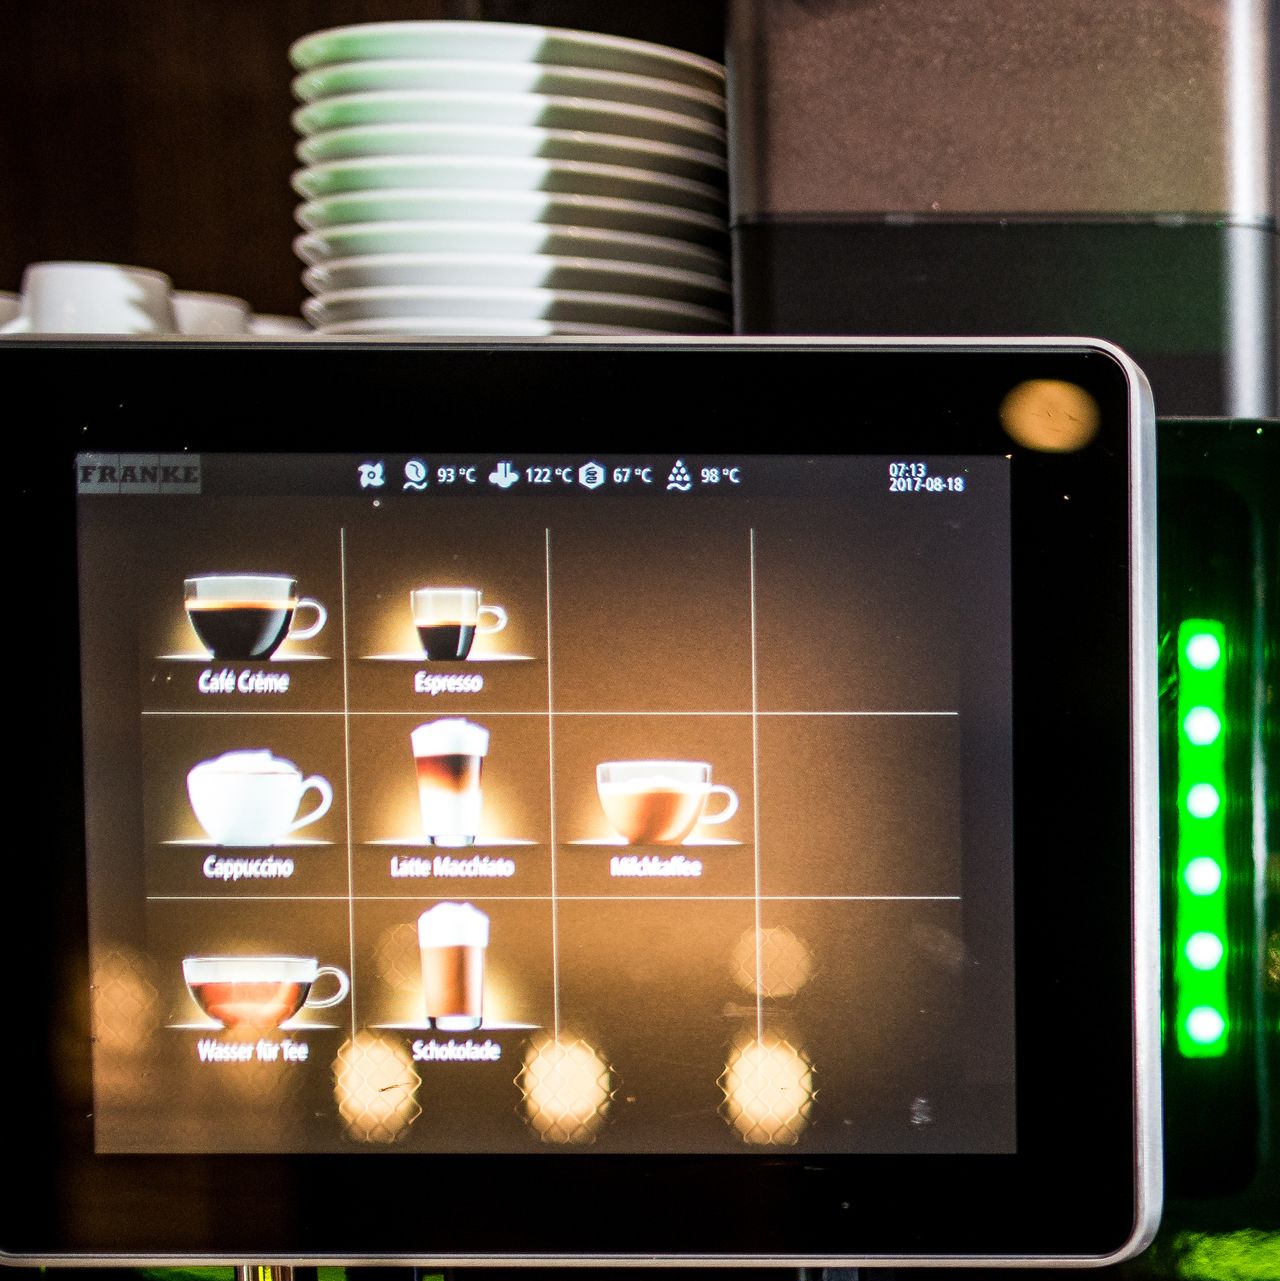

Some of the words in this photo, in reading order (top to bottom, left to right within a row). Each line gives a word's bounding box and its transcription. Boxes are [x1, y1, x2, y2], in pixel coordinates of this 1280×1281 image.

[79, 464, 200, 484] FRANKE
[437, 467, 456, 483] 93
[525, 467, 552, 483] 122
[613, 467, 631, 483] 67
[701, 467, 720, 483] 98
[888, 462, 927, 478] 07:13
[889, 477, 965, 492] 2017-08-18
[198, 667, 237, 694] Café
[237, 669, 291, 694] Crème
[414, 670, 484, 696] Espresso
[202, 854, 295, 882] Cappuccino
[390, 855, 432, 878] Latte
[433, 855, 516, 878] Macchiato
[197, 1038, 254, 1062] Wasser
[280, 1039, 309, 1062] Tee
[412, 1039, 502, 1061] Schokolade
